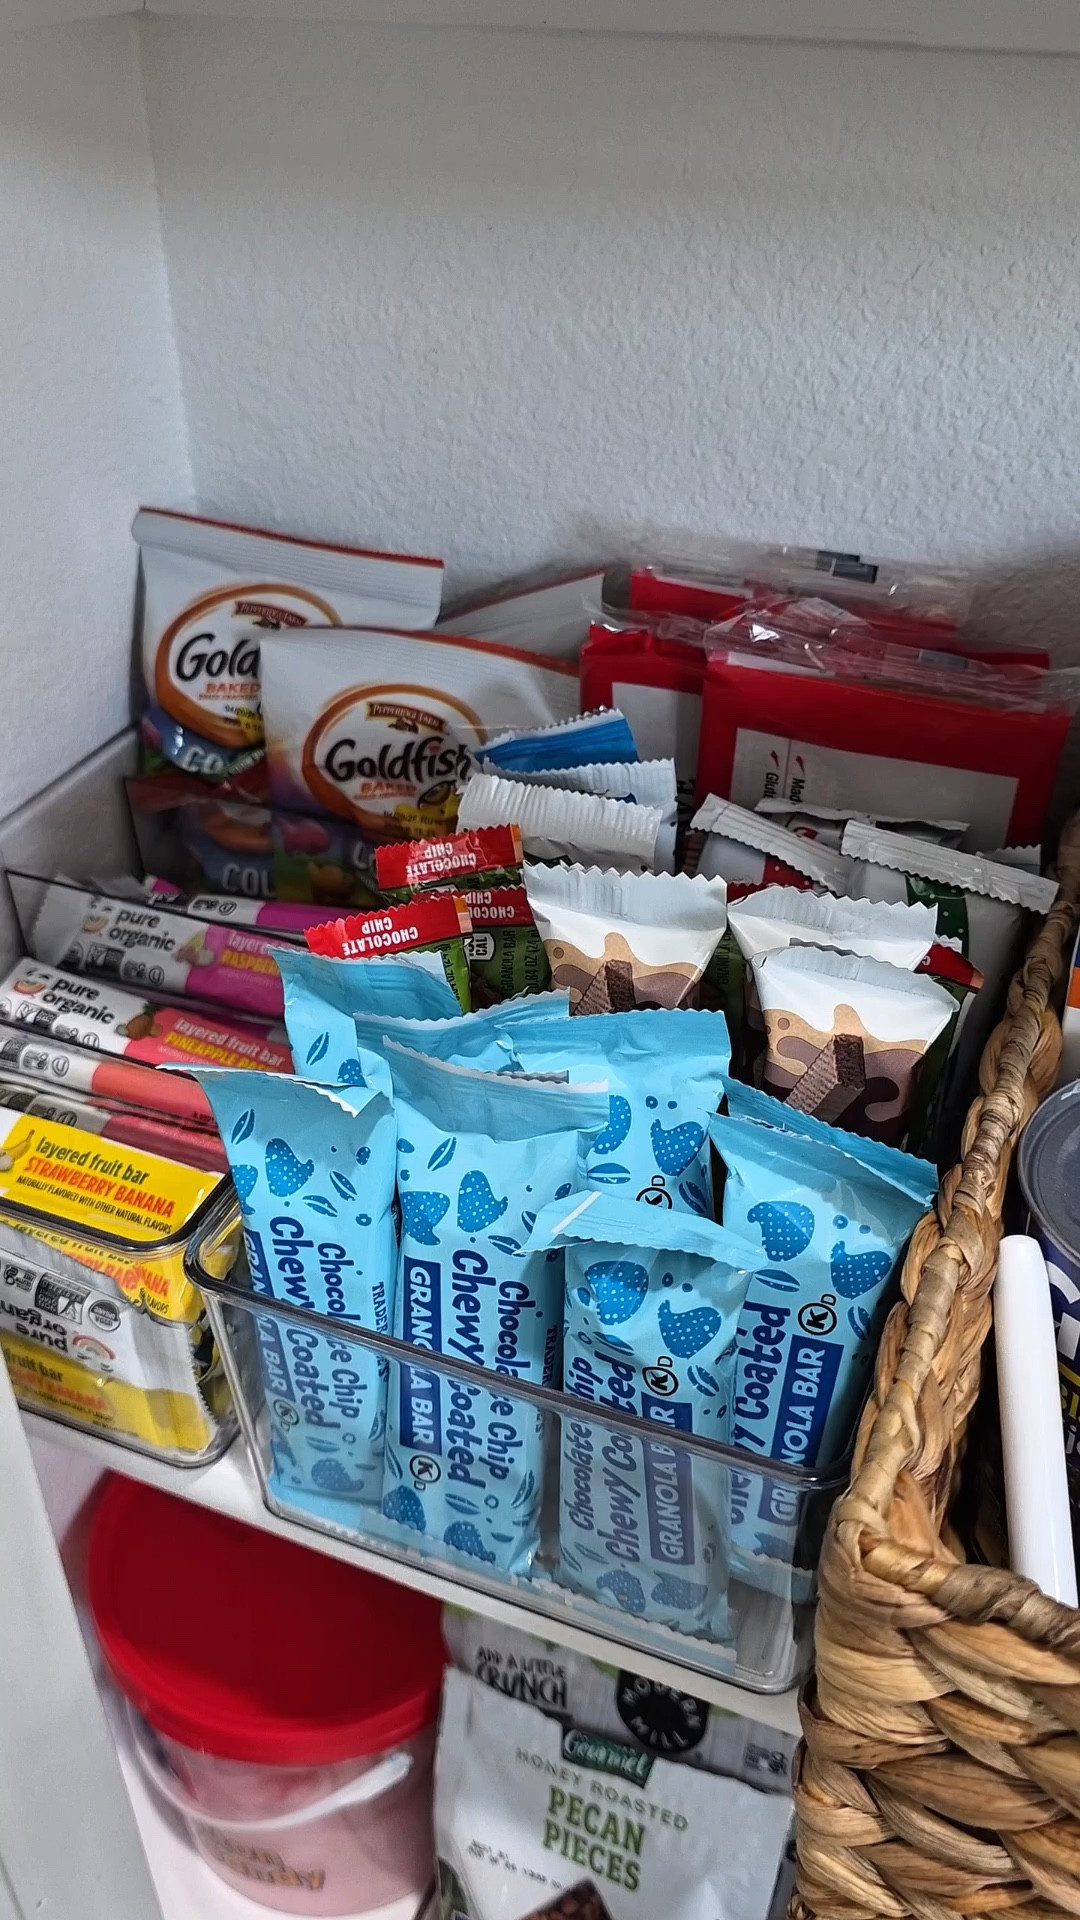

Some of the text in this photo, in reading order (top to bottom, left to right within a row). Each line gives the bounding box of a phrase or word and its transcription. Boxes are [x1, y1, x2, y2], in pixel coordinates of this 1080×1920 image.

[325, 736, 473, 783] Goldfish
[361, 782, 417, 795] BAKED
[406, 853, 477, 878] CHOCOLATE
[424, 842, 453, 859] CHIP
[115, 908, 160, 929] pure
[465, 892, 492, 905] CHIP
[109, 927, 176, 951] organic
[342, 927, 419, 956] CHOCOLATE
[361, 916, 393, 935] CHIP
[476, 936, 488, 956] CAL
[502, 930, 517, 949] BAR
[42, 993, 115, 1025] organic
[52, 978, 100, 1000] pure
[165, 1031, 236, 1063] PINEAPPLE
[175, 1017, 230, 1045] layered
[226, 1036, 260, 1057] fruit
[260, 1046, 285, 1066] bar
[36, 1136, 150, 1185] layered fruit bar
[16, 1175, 174, 1235] NATURALLY FLAVORED WITH OTHER NATURAL FLAVORS
[24, 1156, 176, 1219] STRAWBERRY BANANA
[372, 1281, 390, 1334] TRADER
[447, 1248, 498, 1367] Chewy
[16, 1322, 67, 1352] pure
[735, 1300, 792, 1421] Coated
[262, 1347, 288, 1392] BAR
[286, 1327, 342, 1429] Coated
[799, 1346, 826, 1393] BAR
[328, 1368, 368, 1420] Chip
[409, 1401, 435, 1445] BAR
[564, 1355, 604, 1532] Chocolate hip
[478, 1421, 524, 1480] Chip
[597, 1466, 642, 1563] Chewy
[651, 1461, 686, 1561] GRANOLA
[475, 1662, 568, 1709] CRUNCH
[515, 1748, 690, 1832] HONEY ROASTED
[548, 1784, 646, 1857] PECAN
[542, 1818, 642, 1892] PIECES
